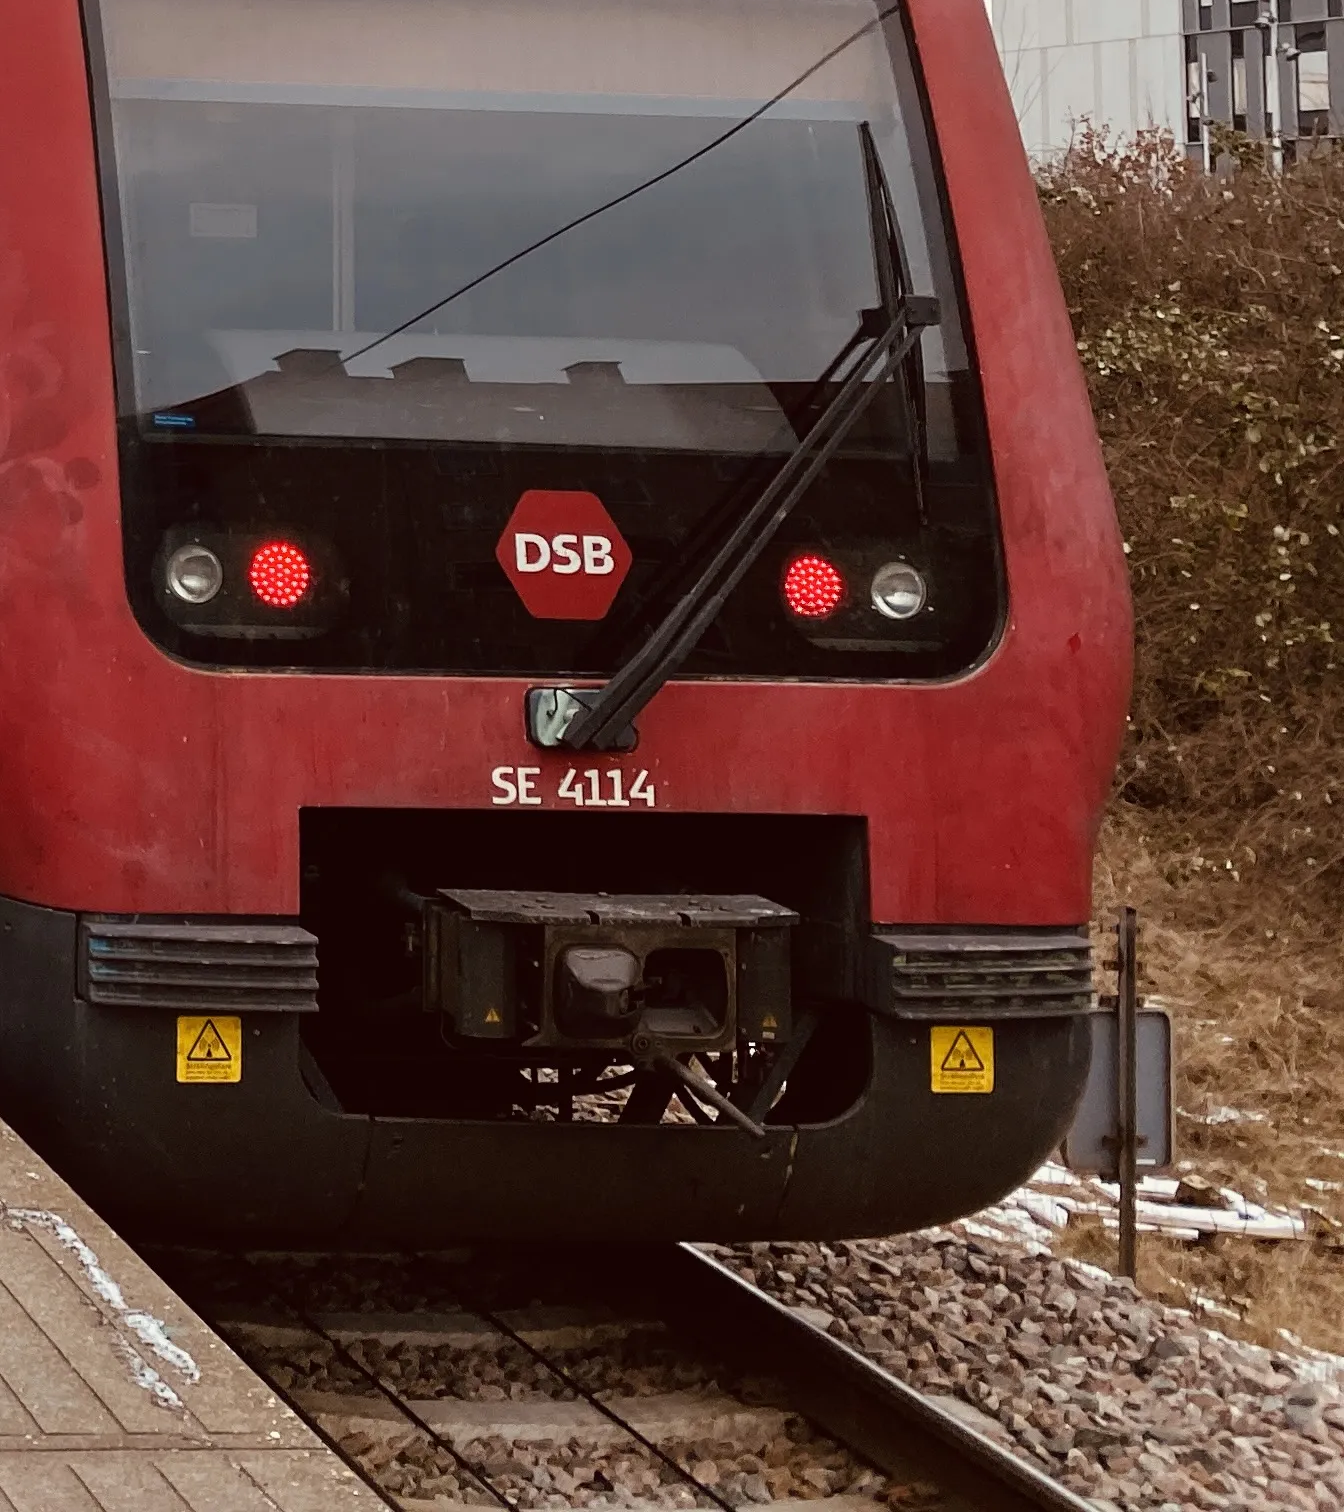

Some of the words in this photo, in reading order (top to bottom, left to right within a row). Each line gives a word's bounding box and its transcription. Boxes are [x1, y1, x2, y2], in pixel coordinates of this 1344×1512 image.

[514, 532, 615, 575] DSB
[491, 766, 542, 805] SE
[557, 768, 656, 807] 4114
